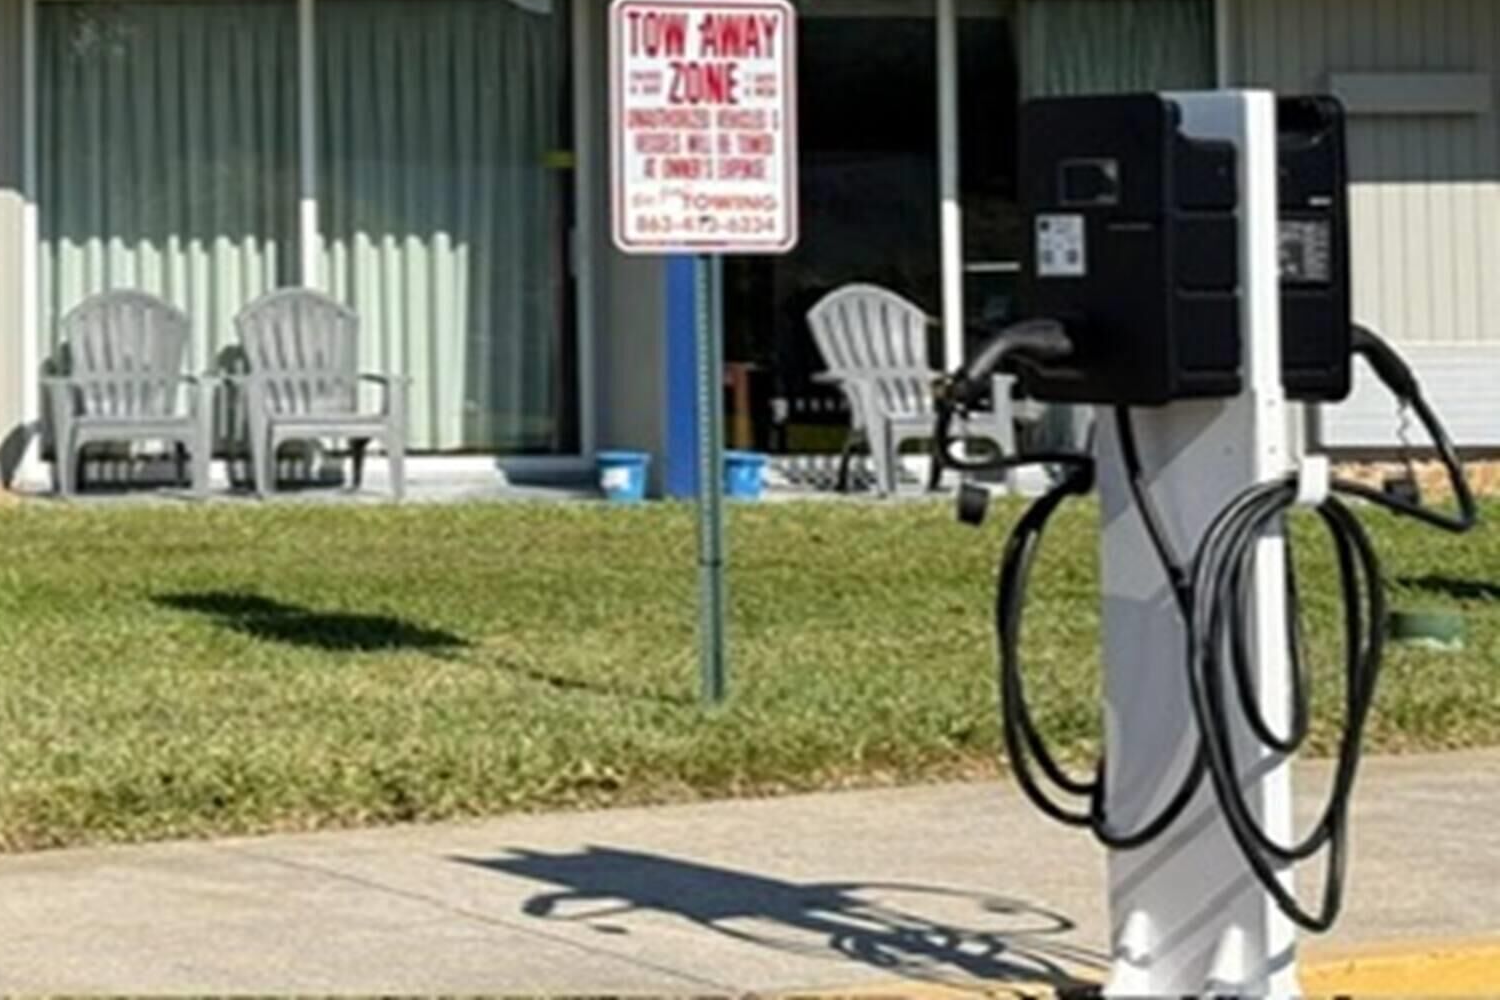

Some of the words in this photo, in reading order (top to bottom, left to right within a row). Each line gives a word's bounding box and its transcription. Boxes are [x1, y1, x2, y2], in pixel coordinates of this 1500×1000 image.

[628, 12, 689, 57] TOW
[702, 12, 778, 58] AWAY
[668, 62, 738, 104] ZONE
[682, 193, 778, 212] TOWING
